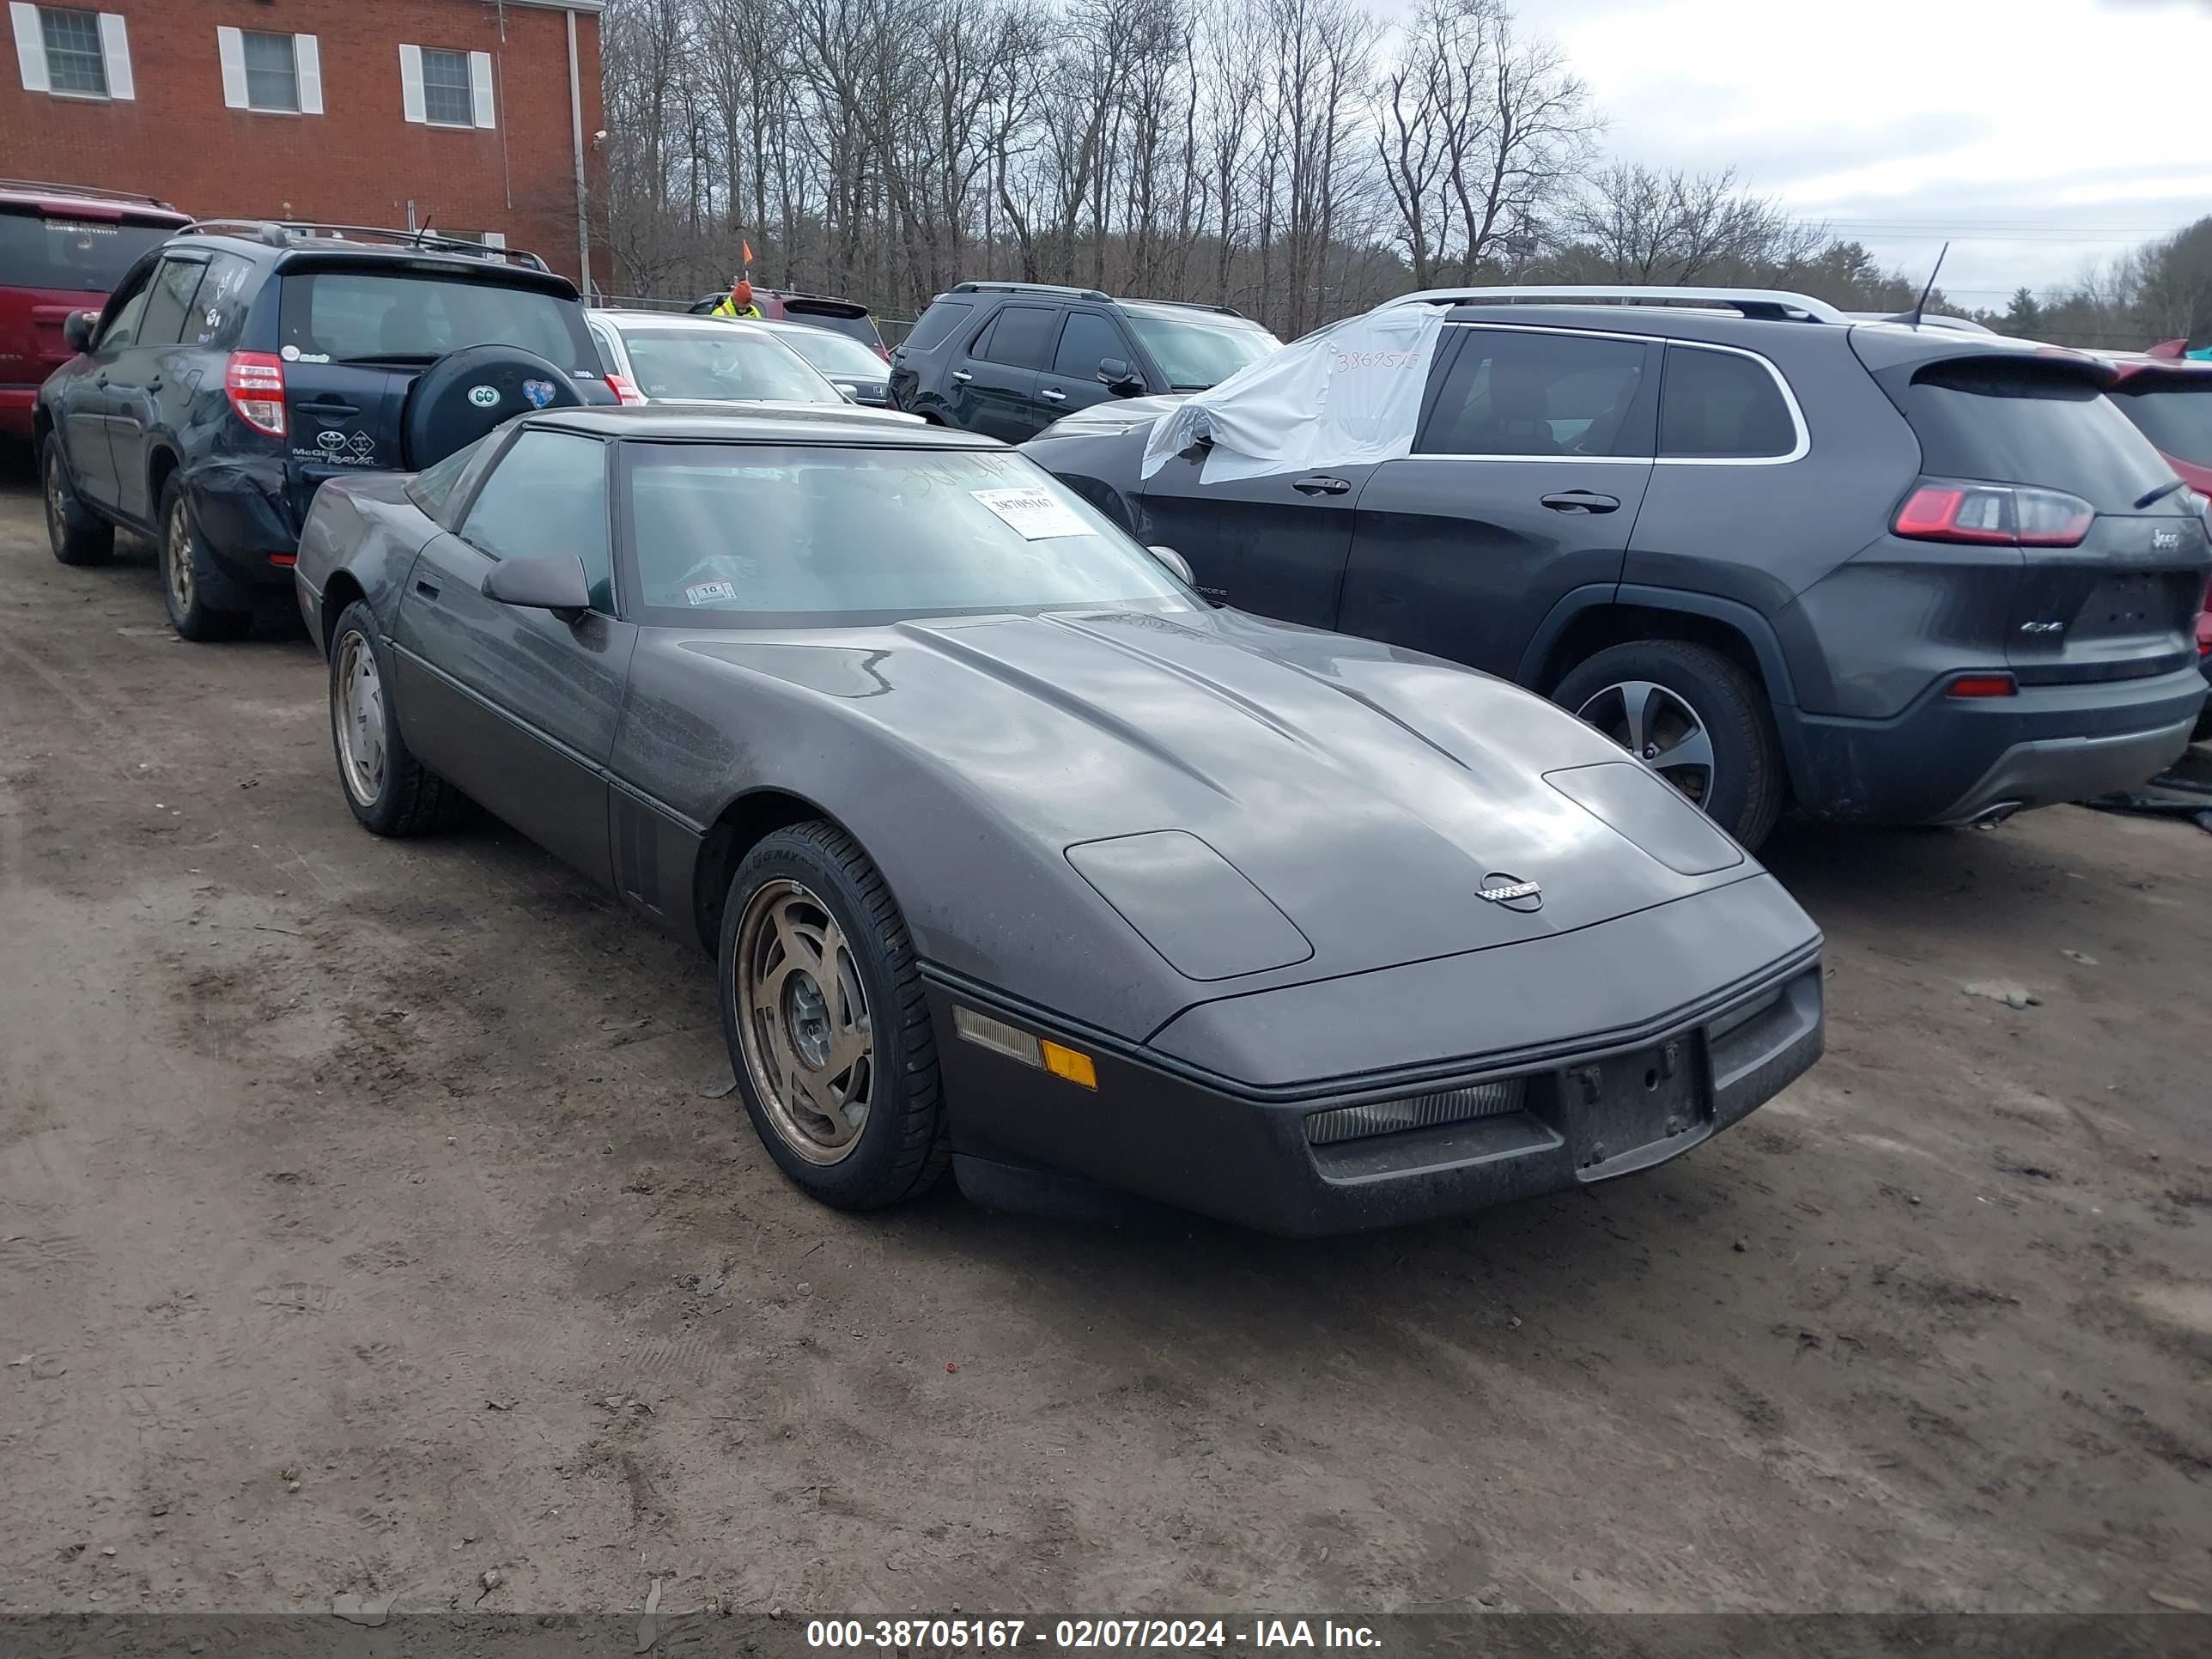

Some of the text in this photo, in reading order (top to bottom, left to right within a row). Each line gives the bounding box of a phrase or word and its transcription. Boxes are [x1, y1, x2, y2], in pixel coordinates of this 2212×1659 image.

[293, 455, 323, 464] TOYOTA
[992, 498, 1054, 511] 38705167
[2153, 528, 2179, 550] Jeep
[702, 586, 718, 594] 10
